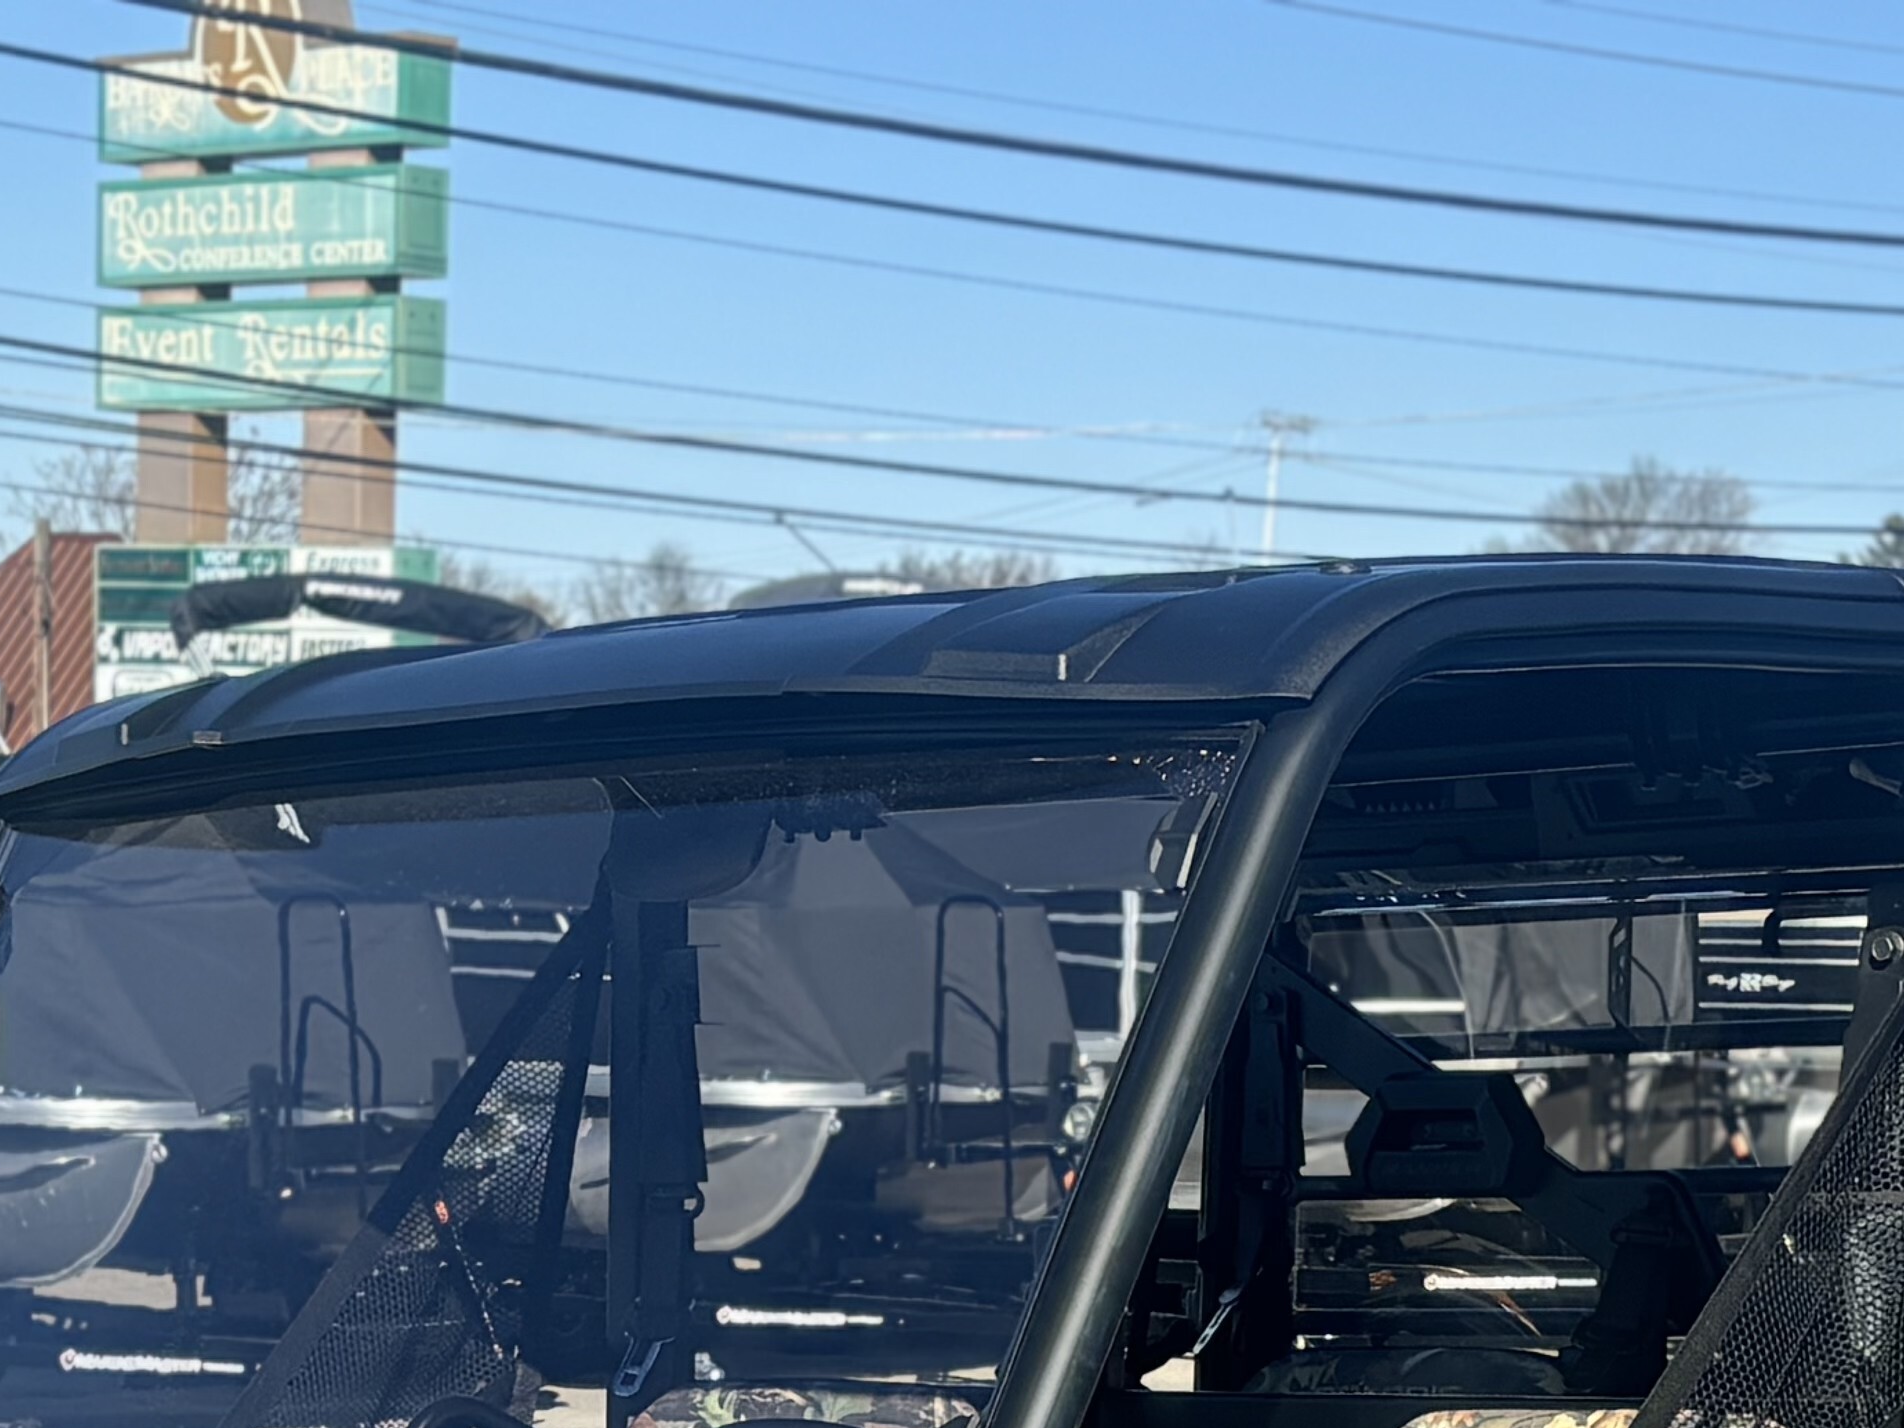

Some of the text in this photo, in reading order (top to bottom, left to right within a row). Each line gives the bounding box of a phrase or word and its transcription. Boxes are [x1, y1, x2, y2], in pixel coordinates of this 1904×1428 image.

[108, 183, 297, 257] Rothchild
[179, 238, 388, 272] CONFERENCE CENTER
[103, 309, 388, 370] Event Rentals
